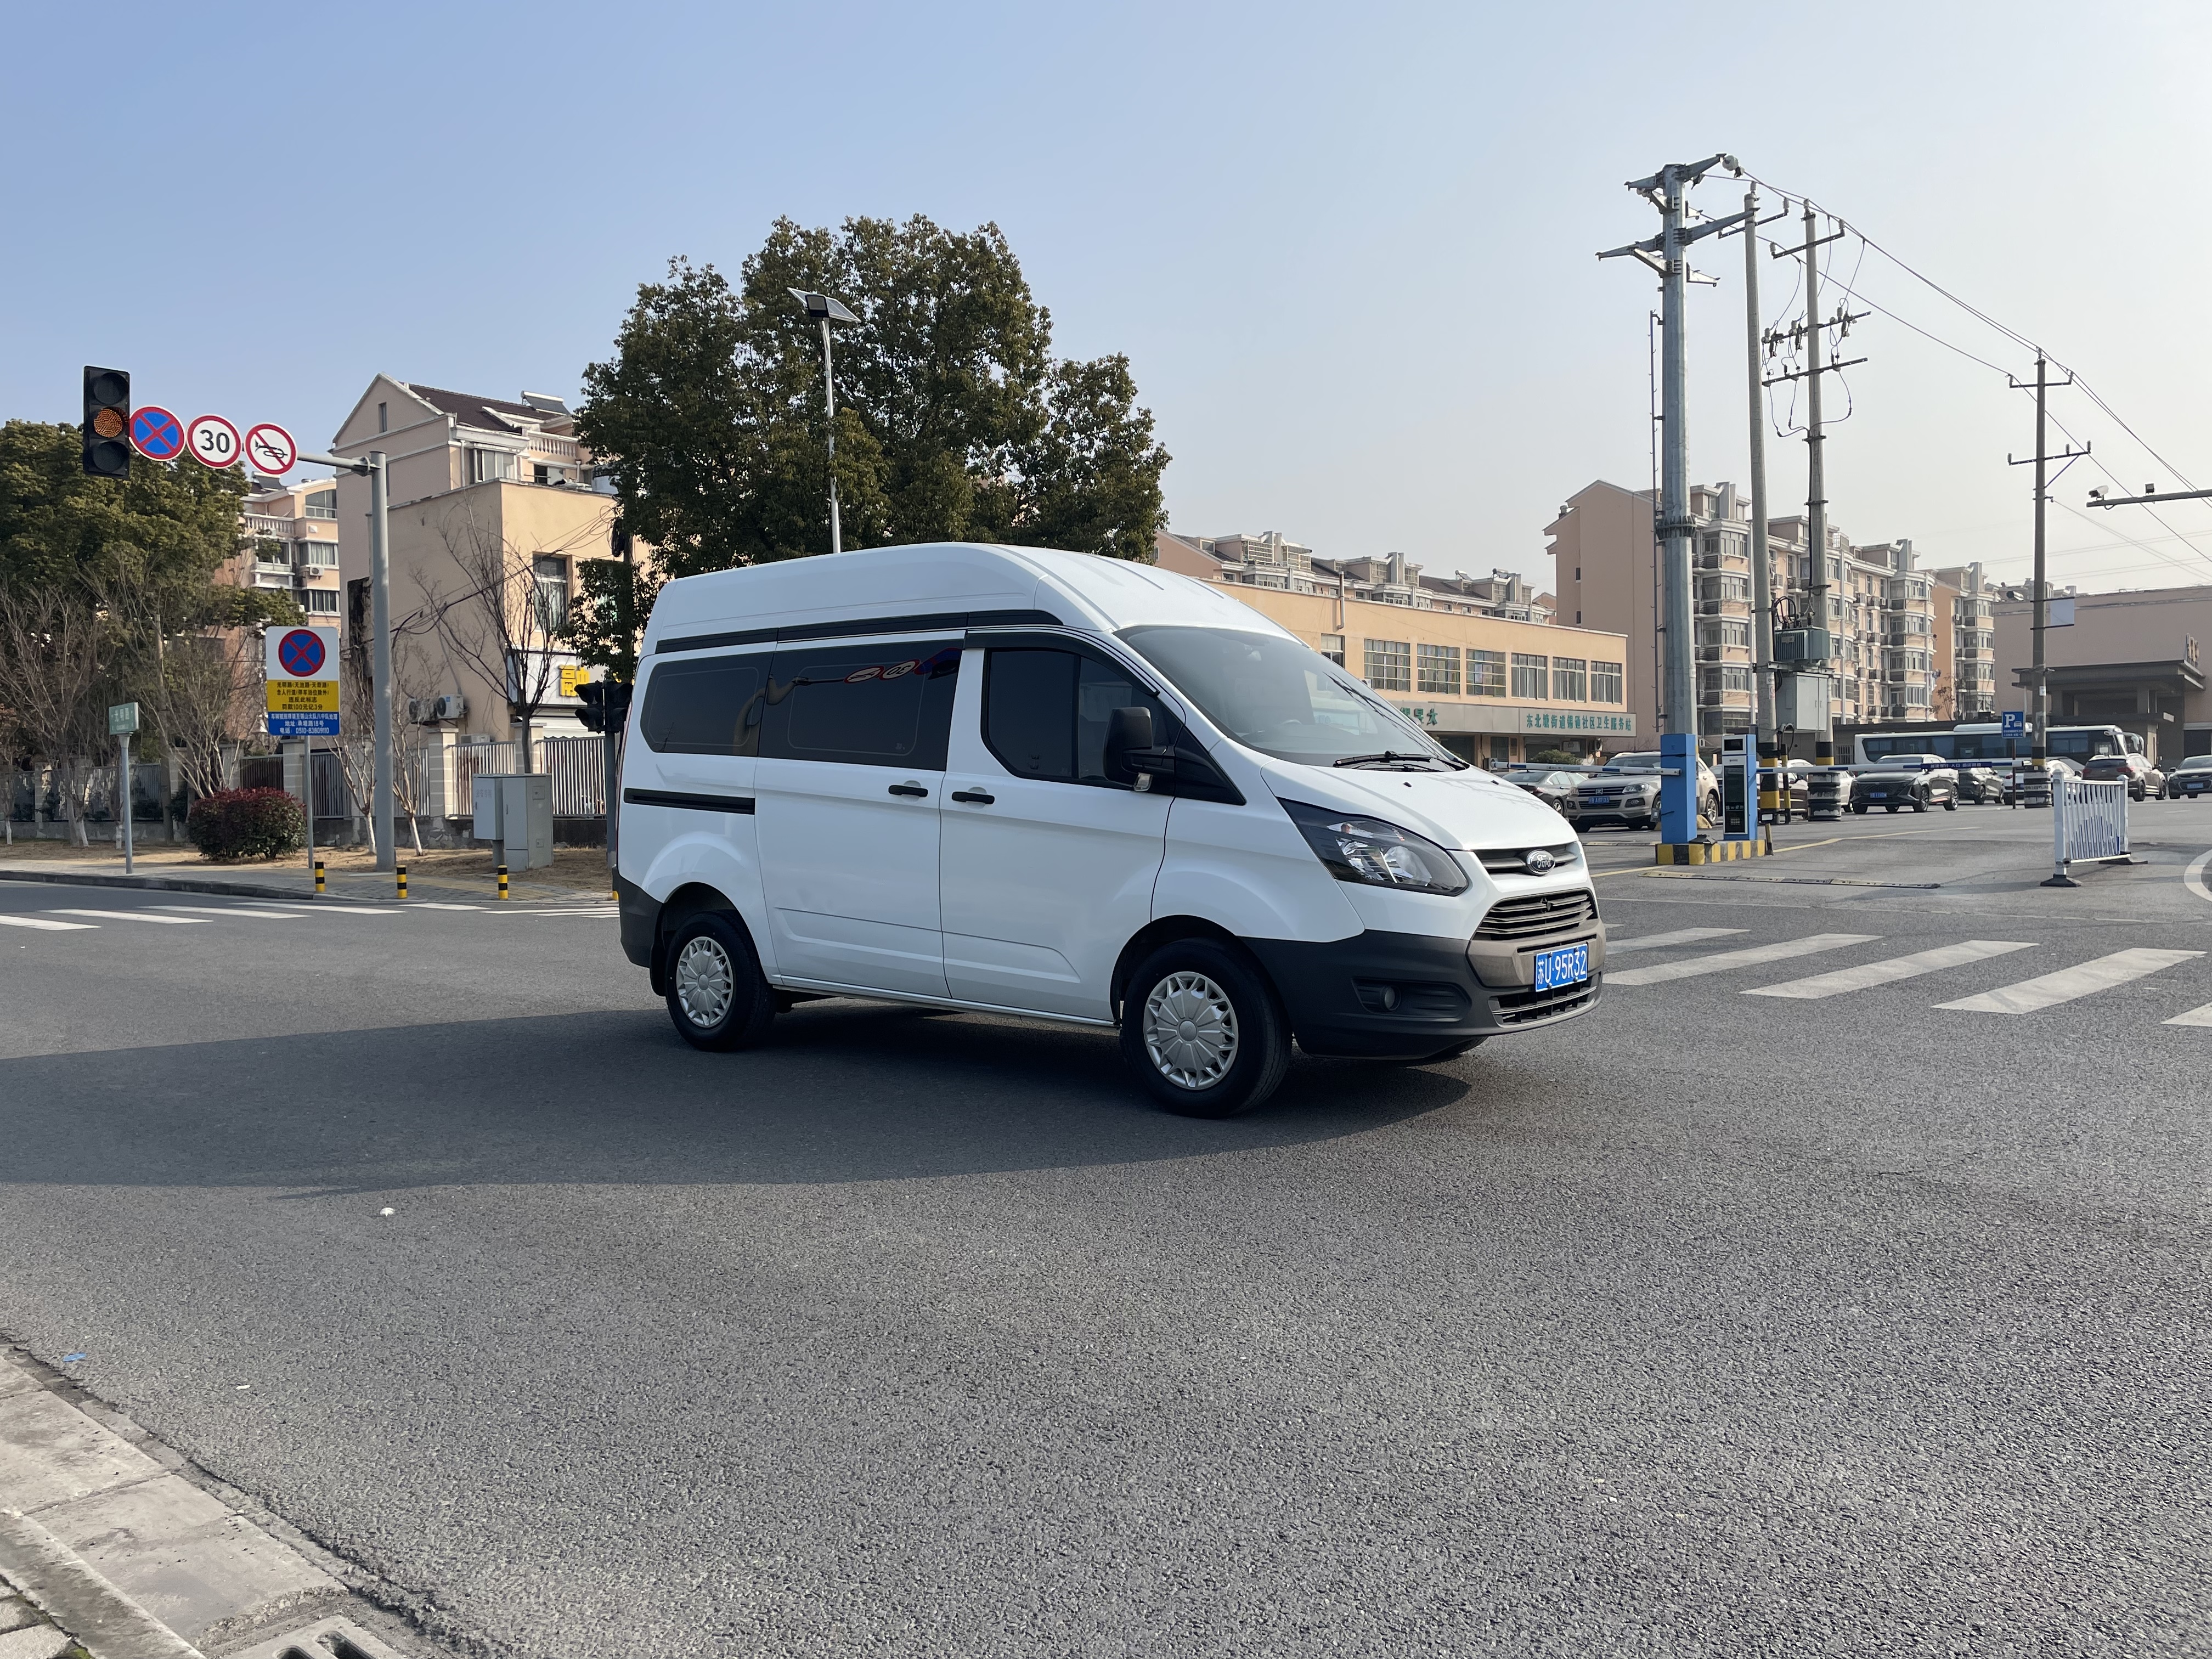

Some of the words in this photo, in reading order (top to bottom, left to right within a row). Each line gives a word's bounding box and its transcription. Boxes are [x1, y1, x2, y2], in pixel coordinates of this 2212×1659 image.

[200, 430, 230, 453] 30
[2004, 714, 2016, 728] P
[1537, 854, 1551, 868] Ford
